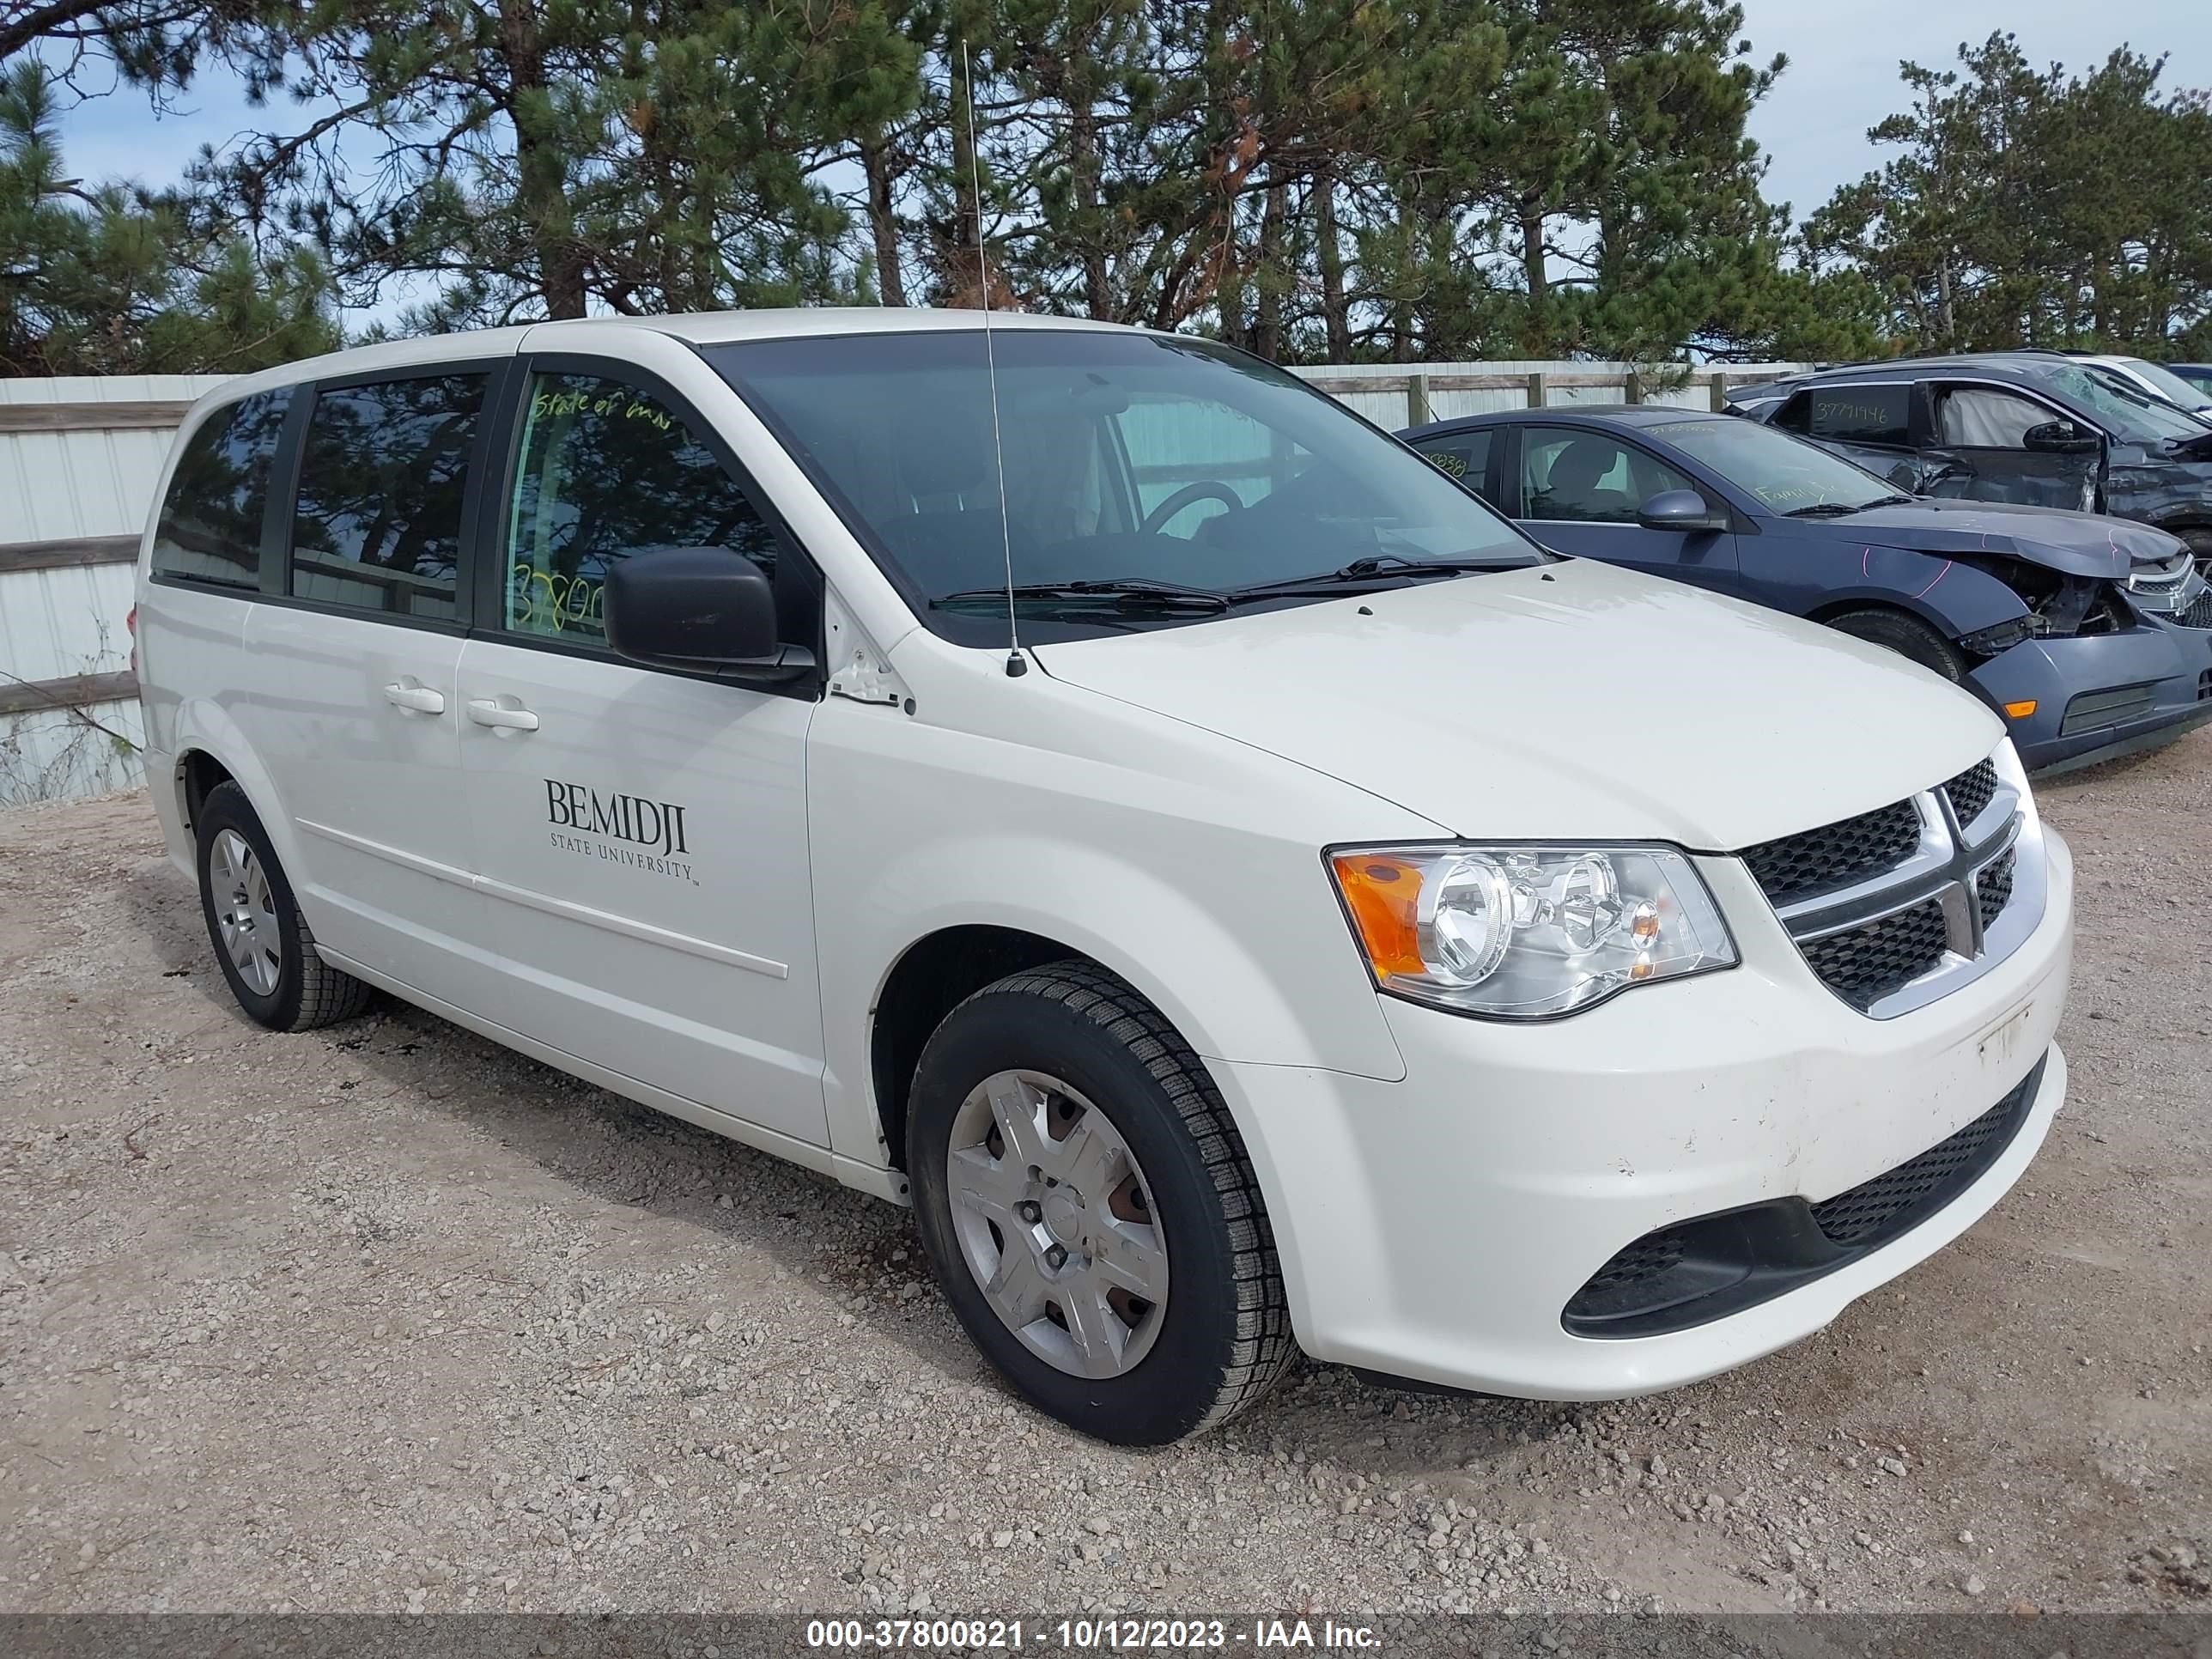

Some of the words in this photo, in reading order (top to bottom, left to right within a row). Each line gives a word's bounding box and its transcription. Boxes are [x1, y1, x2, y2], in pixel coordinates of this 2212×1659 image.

[593, 390, 625, 416] of
[543, 778, 690, 857] BEMIDJI
[550, 832, 592, 855] STATE
[598, 844, 692, 880] UNIVERSITY
